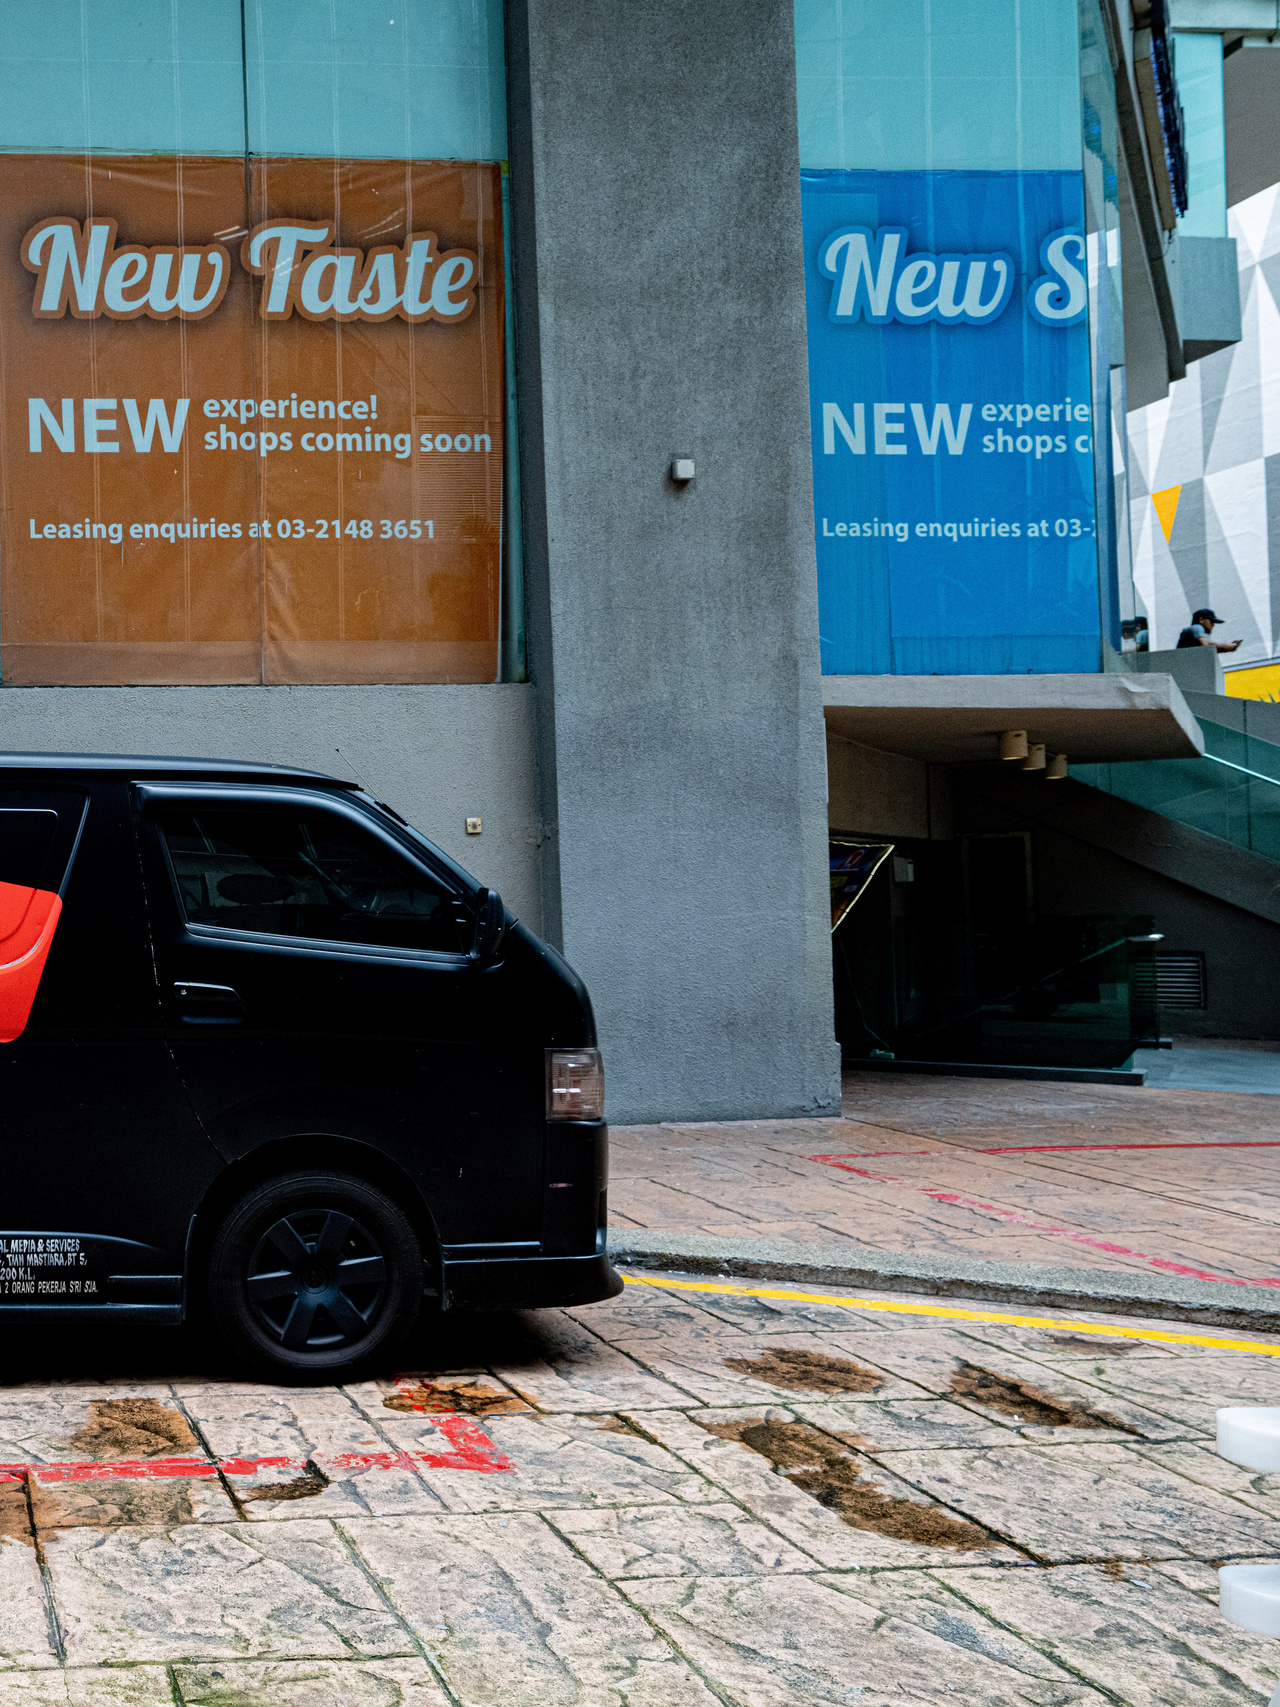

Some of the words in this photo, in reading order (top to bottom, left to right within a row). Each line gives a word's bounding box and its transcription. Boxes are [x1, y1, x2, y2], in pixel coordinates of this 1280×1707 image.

[27, 225, 223, 314] New
[250, 225, 474, 316] Taste
[825, 233, 1008, 317] New
[1035, 234, 1086, 320] S
[202, 393, 379, 424] experience!
[981, 397, 1092, 428] experie
[28, 398, 191, 454] NEW
[203, 424, 293, 457] shops
[300, 426, 412, 459] coming
[420, 431, 492, 453] soon
[822, 402, 973, 455] NEW
[982, 428, 1067, 459] shops
[1075, 434, 1093, 453] c
[29, 518, 123, 543] Leasing
[129, 518, 243, 543] enquiries
[248, 520, 272, 539] at
[276, 519, 374, 539] 03-2148
[379, 519, 435, 539] 3651
[822, 517, 909, 542] Leasing
[915, 517, 1022, 542] enquiries
[1027, 519, 1050, 537] at
[10, 1239, 36, 1253] MEDIA
[37, 1238, 44, 1253] &
[46, 1238, 80, 1253] SERVICES
[4, 1281, 9, 1294] 2
[11, 1281, 35, 1294] ORANG
[38, 1281, 67, 1293] PEKERJA
